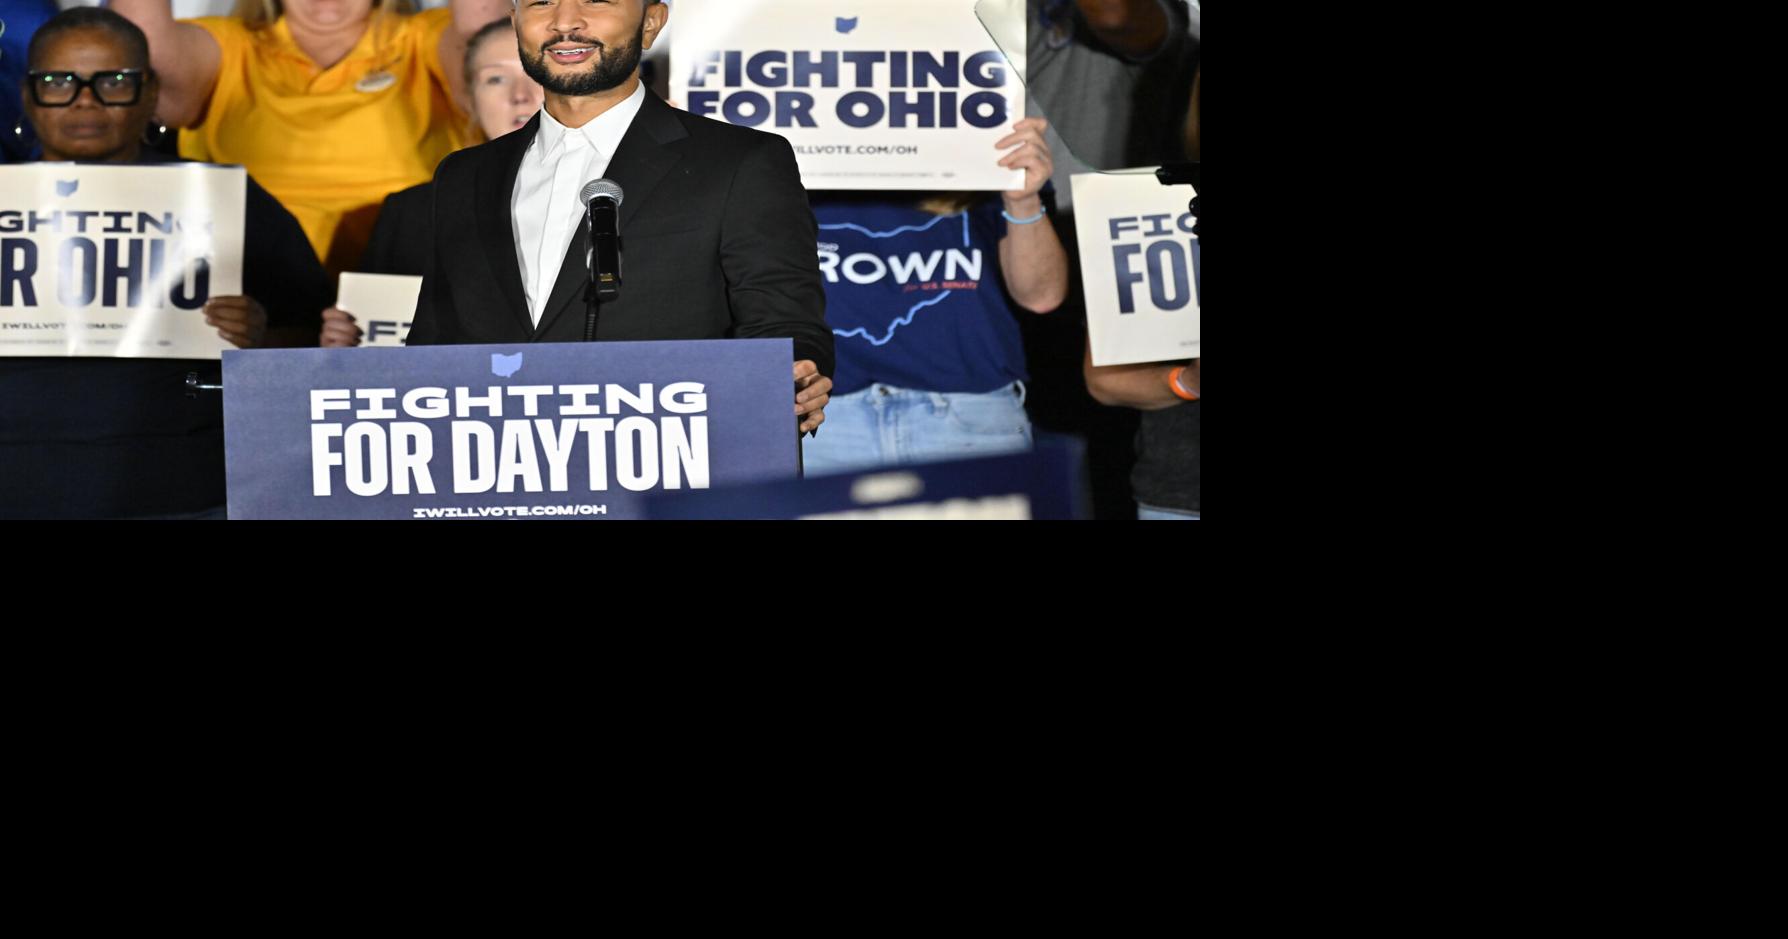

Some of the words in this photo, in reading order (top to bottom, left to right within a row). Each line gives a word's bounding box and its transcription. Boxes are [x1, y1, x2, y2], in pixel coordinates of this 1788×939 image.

[688, 50, 1006, 88] FIGHTING
[688, 91, 818, 128] FOR
[836, 91, 1007, 128] OHIO
[796, 145, 918, 155] ILLVOTE.COM/OH
[0, 211, 182, 233] GHTIN
[817, 248, 982, 285] ROWN
[310, 381, 708, 420] FIGHTING
[311, 420, 436, 497] FOR
[453, 416, 710, 495] DAYTON
[413, 505, 606, 518] IWILLVOTE.COM/OH
